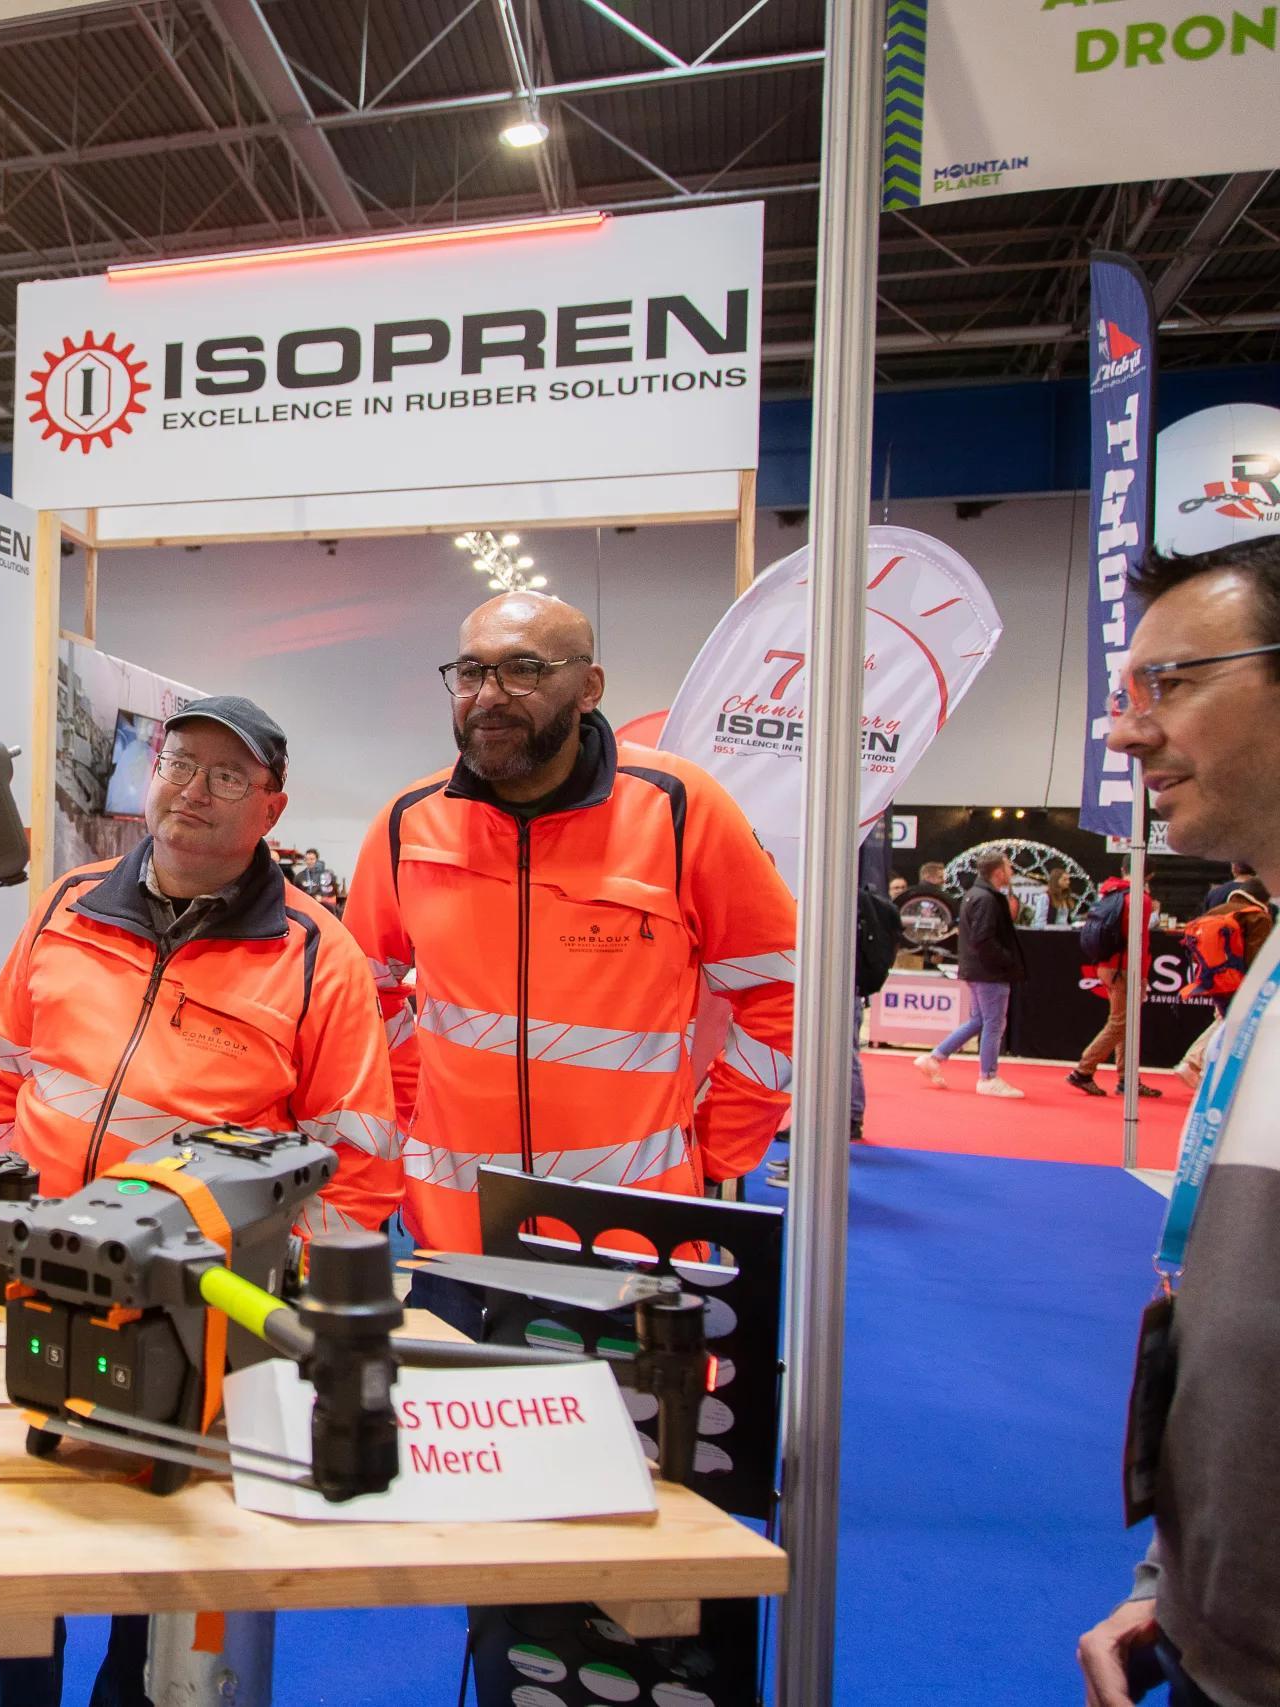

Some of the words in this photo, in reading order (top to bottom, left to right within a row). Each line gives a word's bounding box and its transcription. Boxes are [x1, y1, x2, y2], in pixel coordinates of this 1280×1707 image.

[1075, 6, 1278, 73] DRON
[933, 156, 1029, 180] MOUNTAIN
[933, 172, 1003, 193] PLANET
[163, 288, 749, 400] ISOPREN
[162, 398, 353, 431] EXCELLENCE
[364, 396, 393, 415] IN
[405, 384, 537, 412] RUBBER
[548, 367, 748, 402] SOLUTIONS
[715, 735, 779, 749] EXCELLENCE
[782, 743, 793, 752] IN
[870, 763, 895, 774] 2023
[560, 935, 630, 943] COMBLOUX
[903, 993, 952, 1012] RUD
[182, 1031, 248, 1052] COMBLOUX
[426, 1396, 585, 1431] TOUCHER
[410, 1442, 502, 1474] Merci
